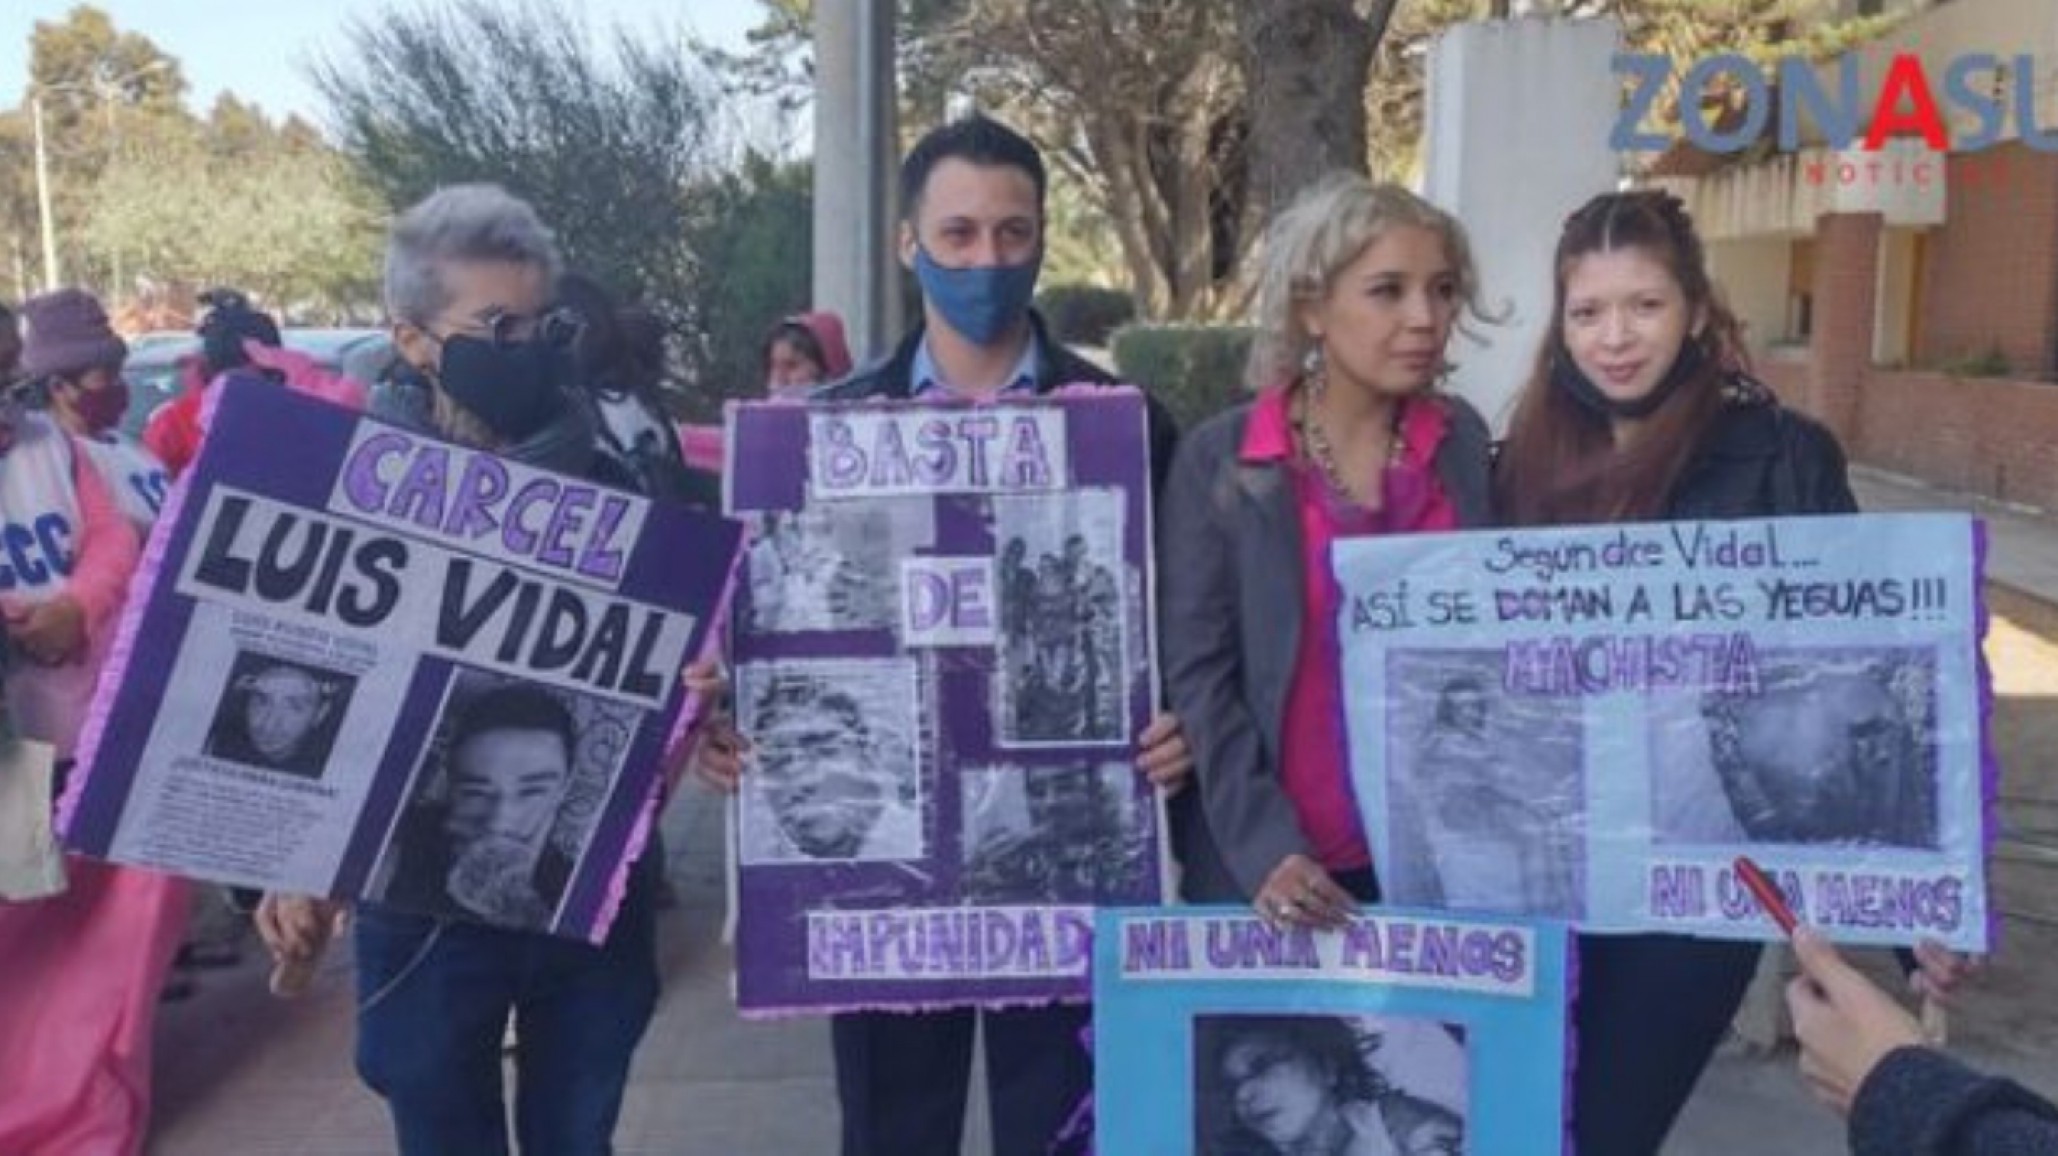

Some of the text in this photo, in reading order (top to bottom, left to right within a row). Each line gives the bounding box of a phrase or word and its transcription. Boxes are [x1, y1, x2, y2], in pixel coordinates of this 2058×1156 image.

[824, 416, 1050, 489] BASTA
[342, 431, 632, 582] CARCEL
[194, 496, 668, 699] LUIS VIDAL
[909, 567, 989, 631] DE
[1427, 590, 1476, 625] SE
[1494, 584, 1613, 623] DOMAN
[1627, 584, 1653, 623] A
[1673, 582, 1745, 621] LAS
[1502, 631, 1761, 697] MACHISTA
[1651, 864, 1707, 918] NI
[1813, 871, 1963, 931] MENOS
[811, 911, 1089, 973] IMPUNIDAD
[1124, 920, 1525, 982] NI UNA MENOS
